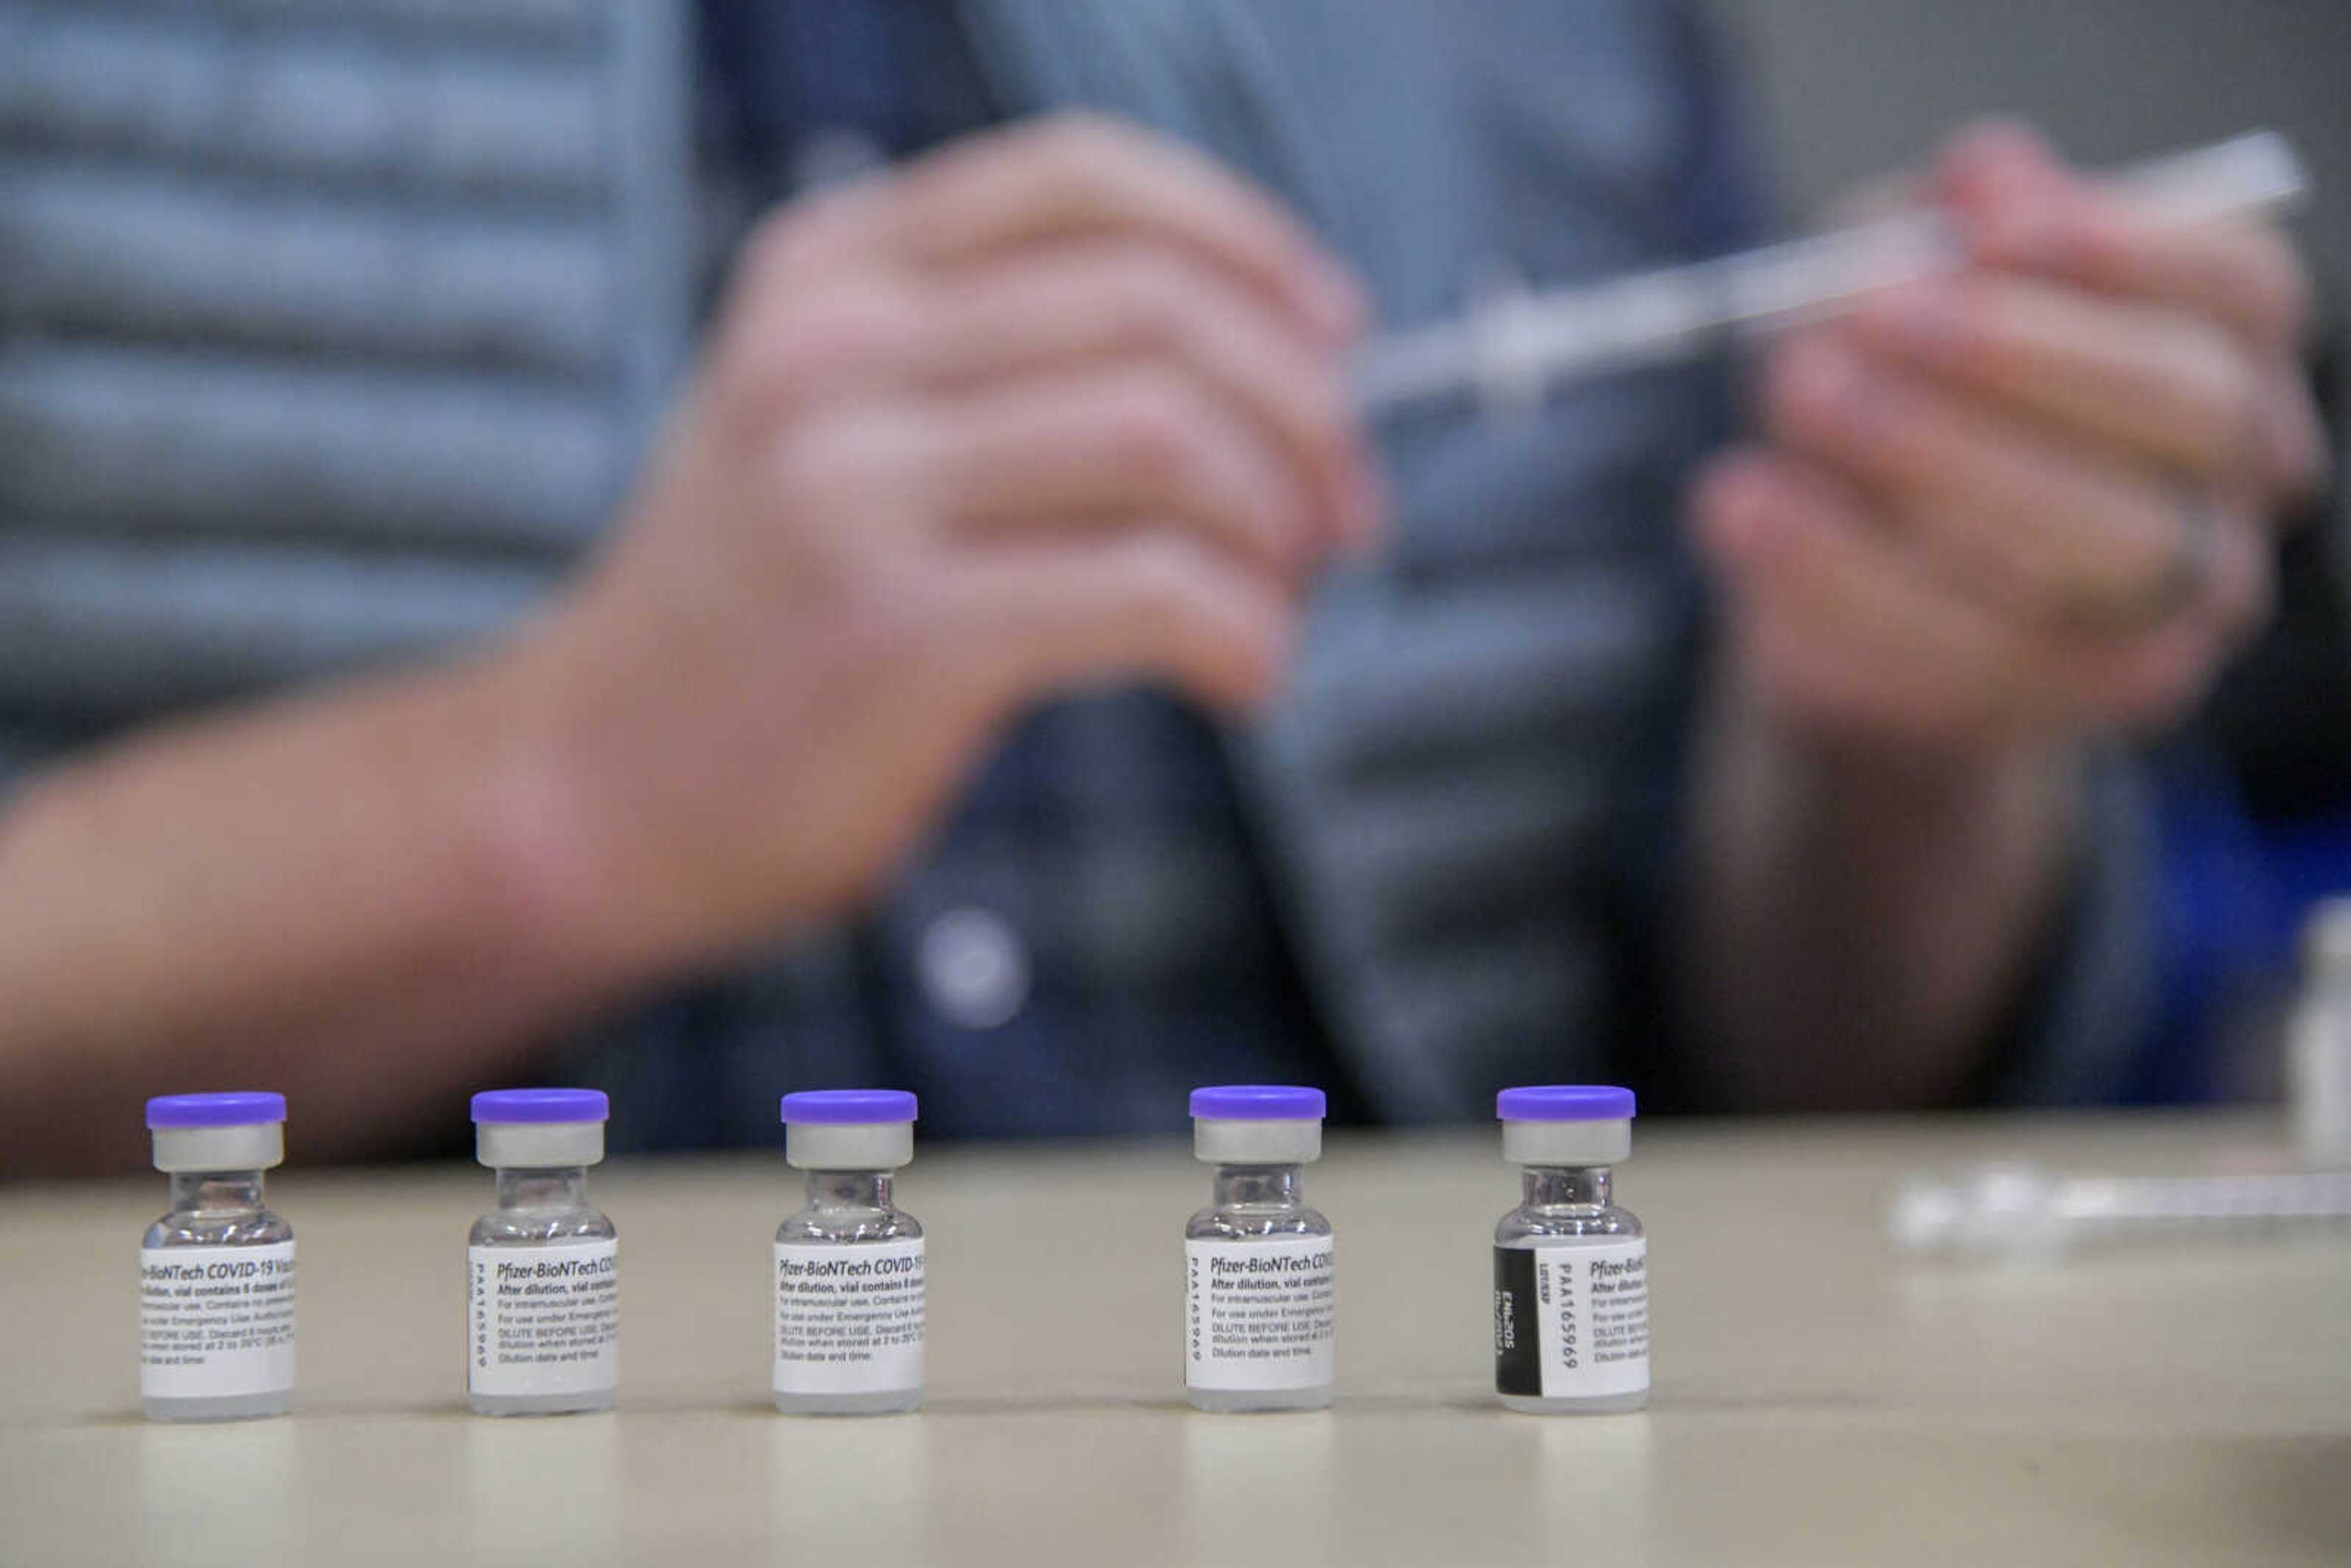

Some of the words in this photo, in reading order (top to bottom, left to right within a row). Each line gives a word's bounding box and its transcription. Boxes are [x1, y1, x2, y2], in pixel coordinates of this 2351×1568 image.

[207, 1260, 273, 1280] COVID-19
[497, 1261, 598, 1281] Pfizer-BioNTech
[779, 1259, 871, 1278] Pfizer-BioNTech
[1210, 1255, 1310, 1275] Pfizer-BioNTech
[497, 1284, 522, 1294] After
[525, 1283, 568, 1295] dilution,
[572, 1281, 588, 1292] vial
[798, 1282, 837, 1294] dilution,
[841, 1281, 859, 1292] vial
[1212, 1278, 1234, 1289] After
[1237, 1278, 1281, 1289] dilution,
[1284, 1277, 1301, 1288] vial
[175, 1286, 191, 1296] vial
[195, 1285, 240, 1296] contains
[836, 1311, 892, 1322] Emergency
[1212, 1308, 1226, 1318] For
[1559, 1262, 1578, 1369] PAA165969
[1212, 1323, 1246, 1333] DILUTE
